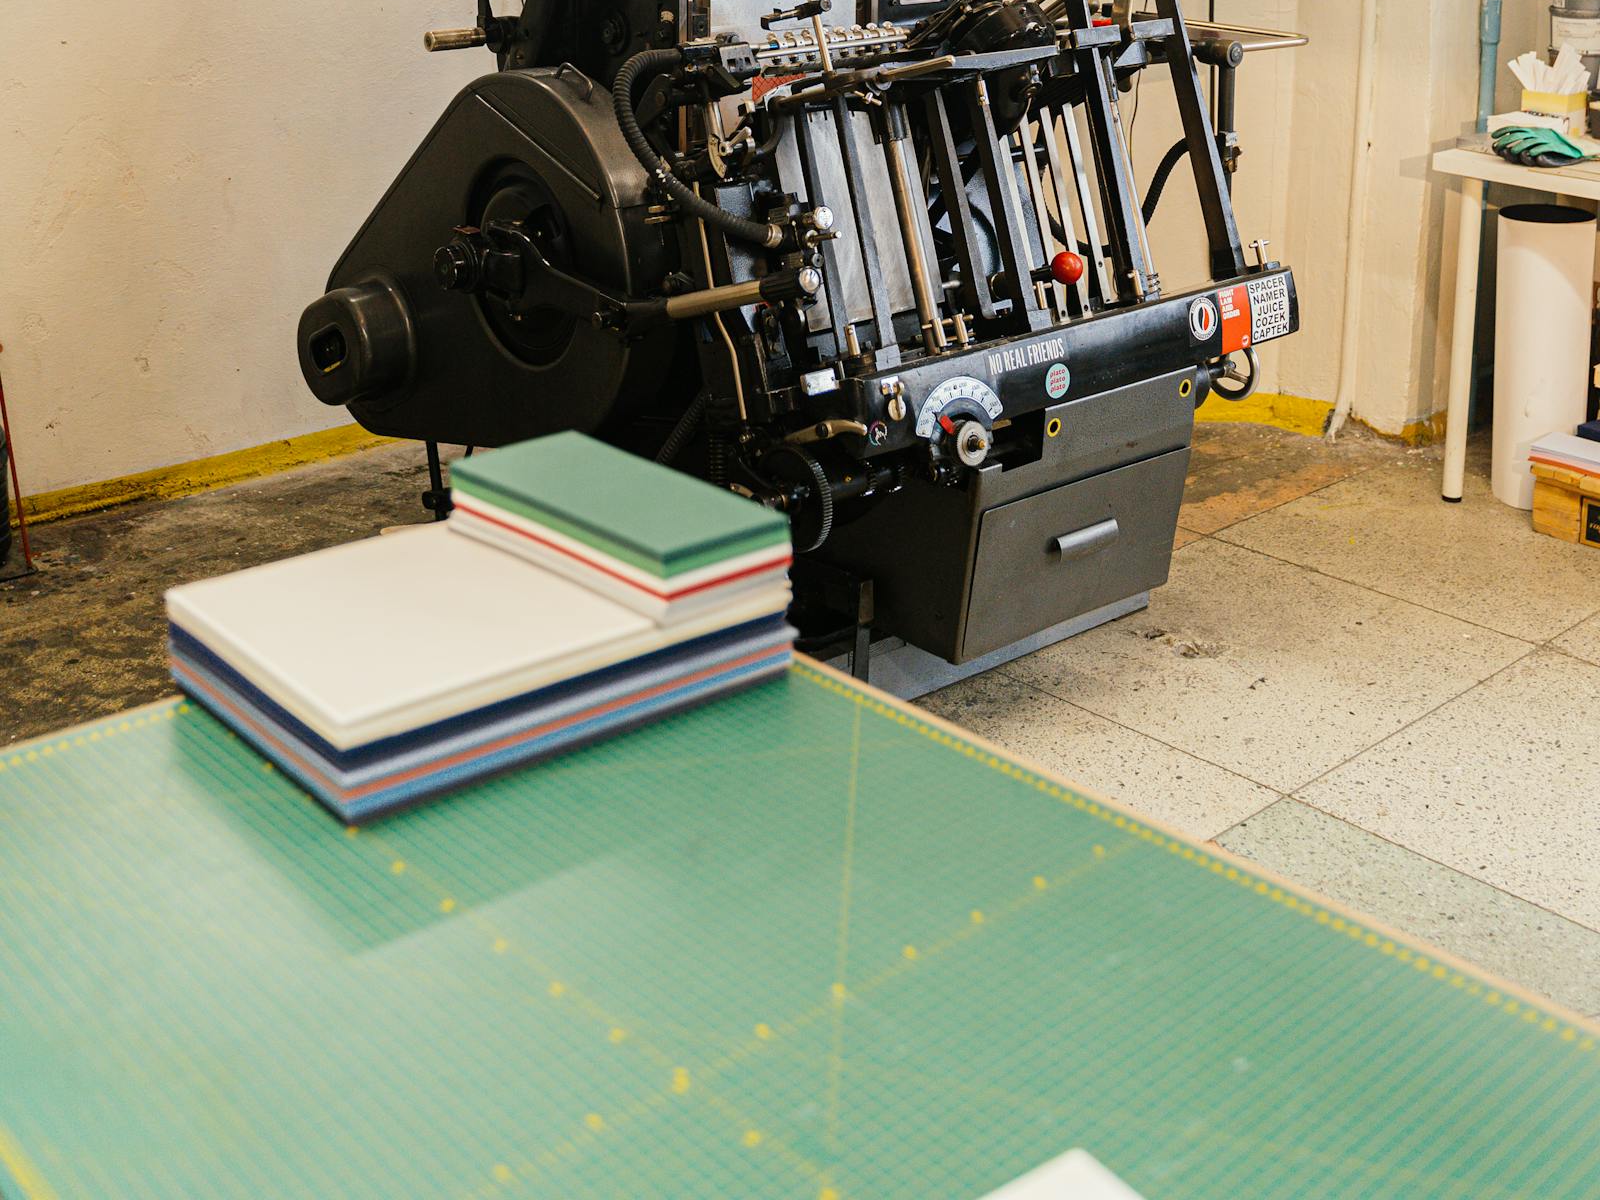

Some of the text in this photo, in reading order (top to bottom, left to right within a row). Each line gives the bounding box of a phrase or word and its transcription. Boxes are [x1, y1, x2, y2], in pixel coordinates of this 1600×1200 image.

[1249, 276, 1285, 294] SPACER
[1253, 288, 1286, 305] NAMER
[1257, 301, 1284, 316] JUICE
[1256, 311, 1286, 328] COZEK
[1253, 322, 1289, 341] CAPTEK
[988, 337, 1065, 376] NO REAL FRIENDS
